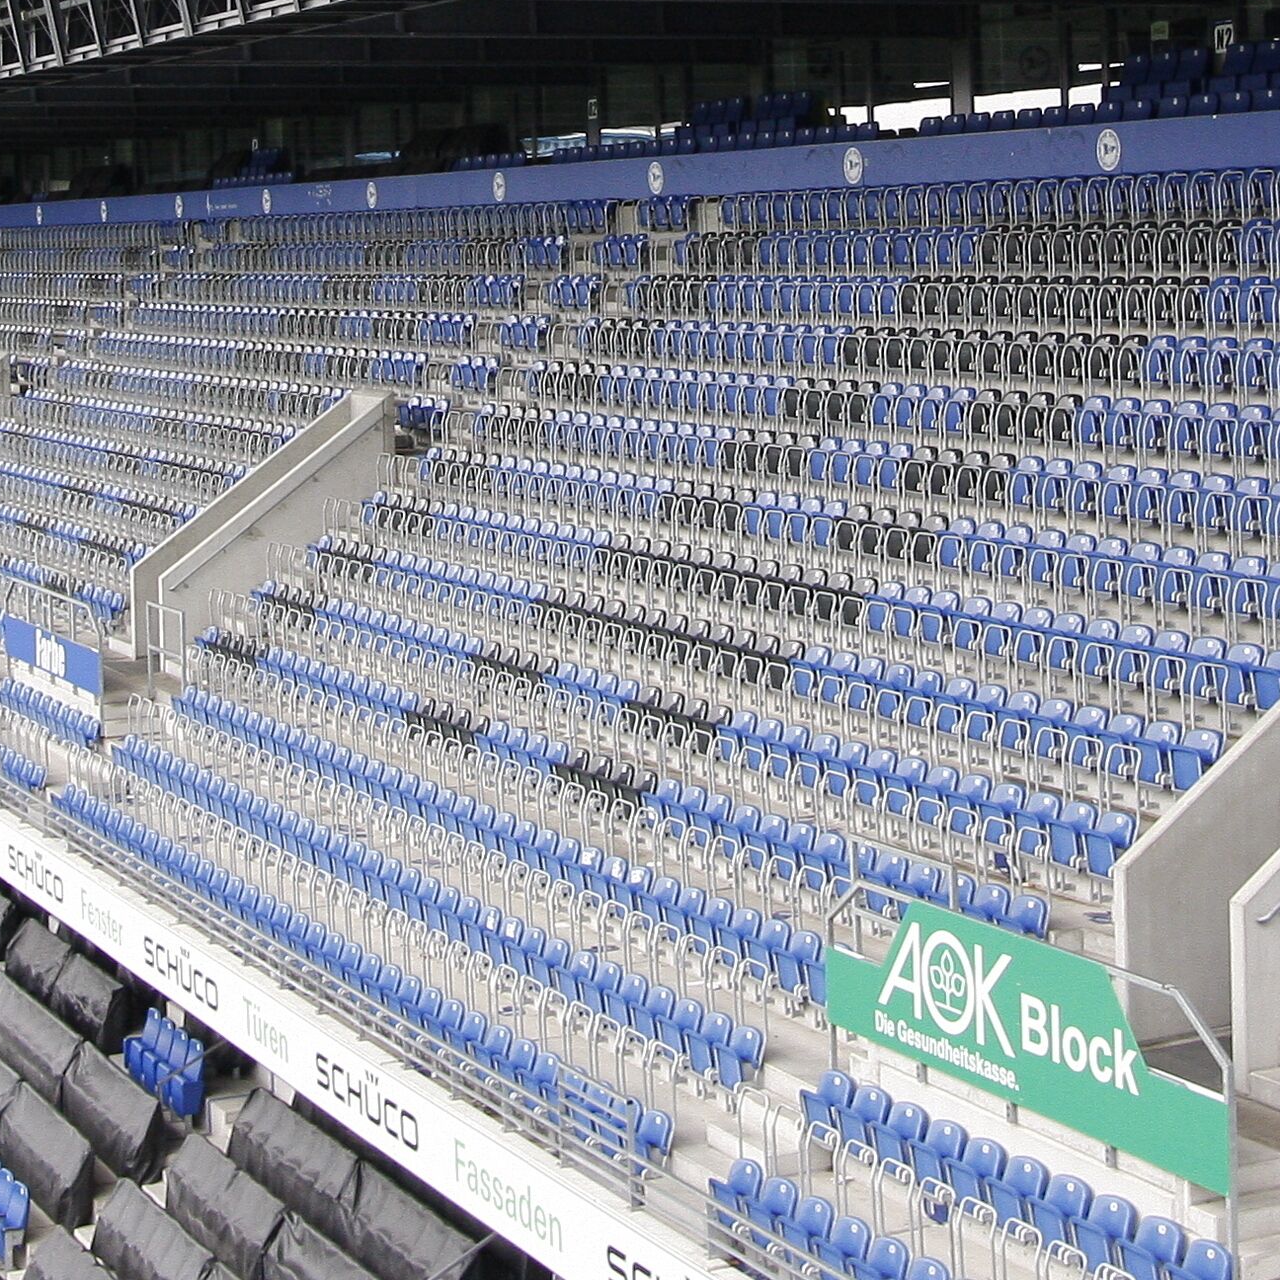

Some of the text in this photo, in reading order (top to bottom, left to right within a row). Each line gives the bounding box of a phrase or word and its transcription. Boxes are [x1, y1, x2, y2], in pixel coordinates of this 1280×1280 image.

[35, 628, 66, 678] Farbe
[7, 844, 65, 904] SCHÜCO
[81, 887, 123, 946] Fenster
[143, 935, 219, 1011] SCHÜCO
[242, 995, 289, 1064] Türen
[315, 1052, 419, 1152] SCHÜCO
[453, 1137, 564, 1253] Fassaden
[874, 1009, 1020, 1091] Die Gesundheitskasse.
[877, 921, 1139, 1096] AOK Block
